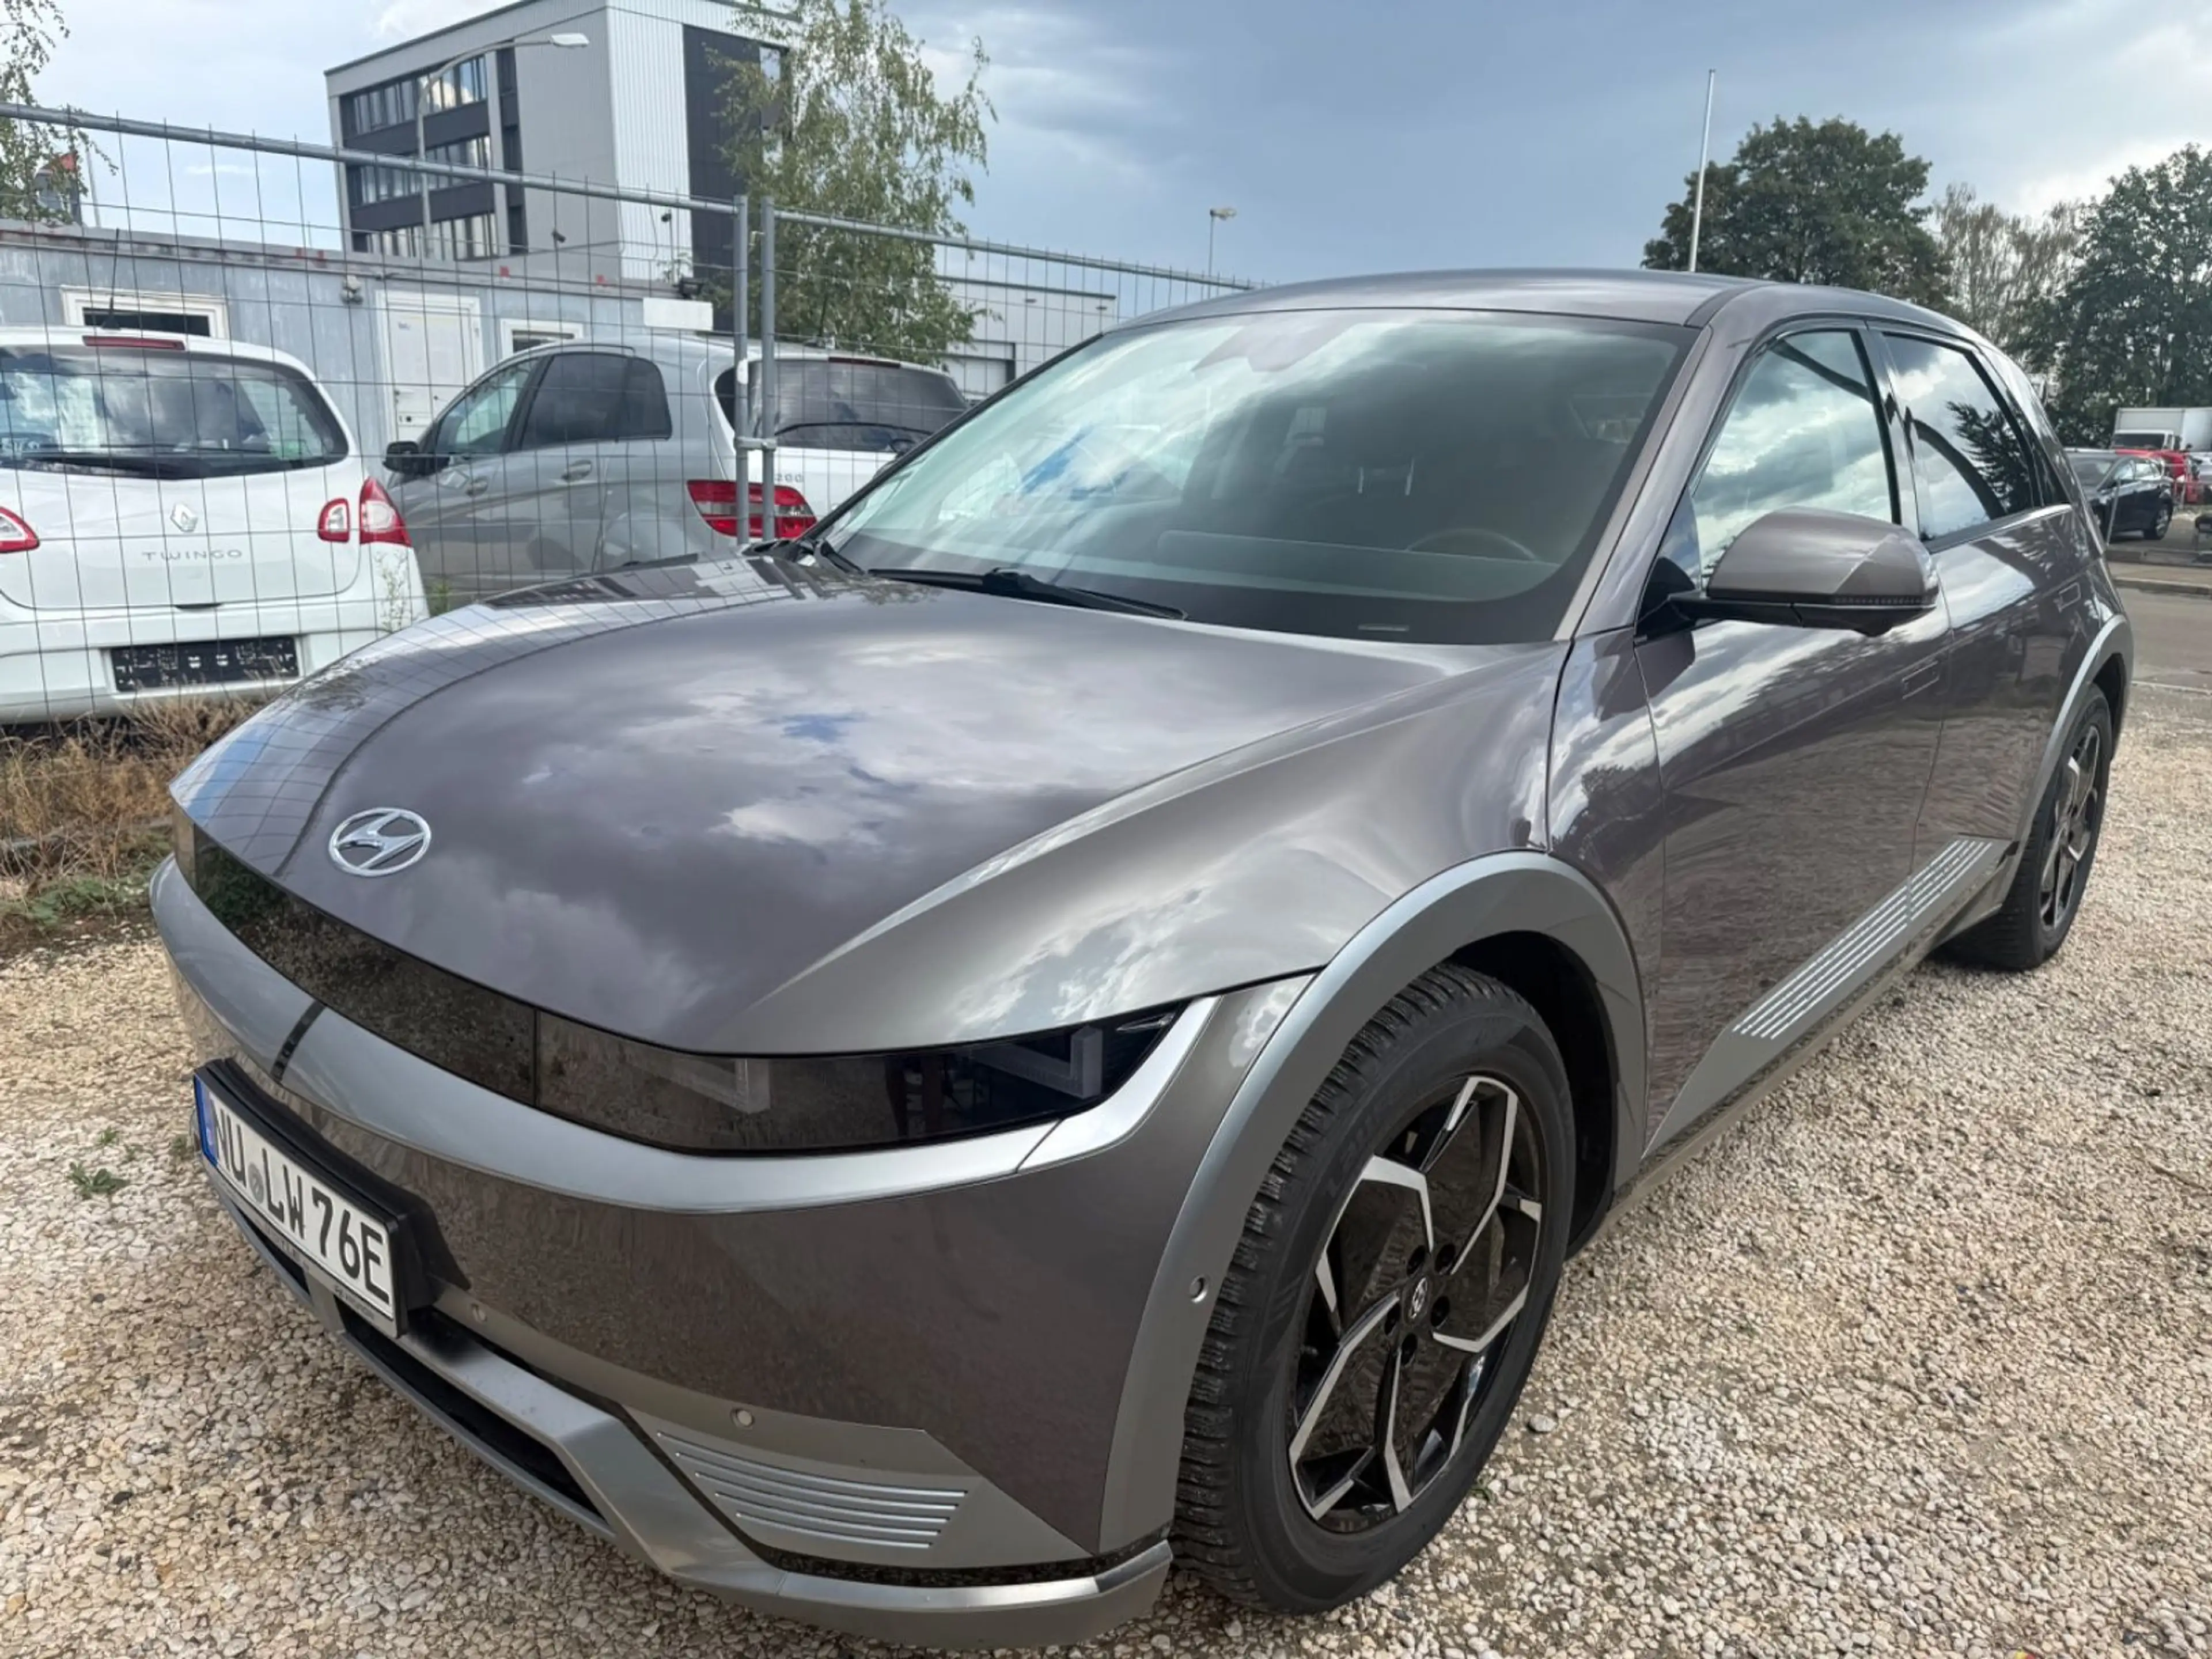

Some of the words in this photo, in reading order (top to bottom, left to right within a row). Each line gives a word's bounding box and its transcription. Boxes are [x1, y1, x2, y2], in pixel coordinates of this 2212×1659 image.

[142, 550, 242, 561] TWINGO
[210, 1099, 247, 1188] NU
[262, 1148, 305, 1240] LW
[311, 1186, 390, 1305] 76E
